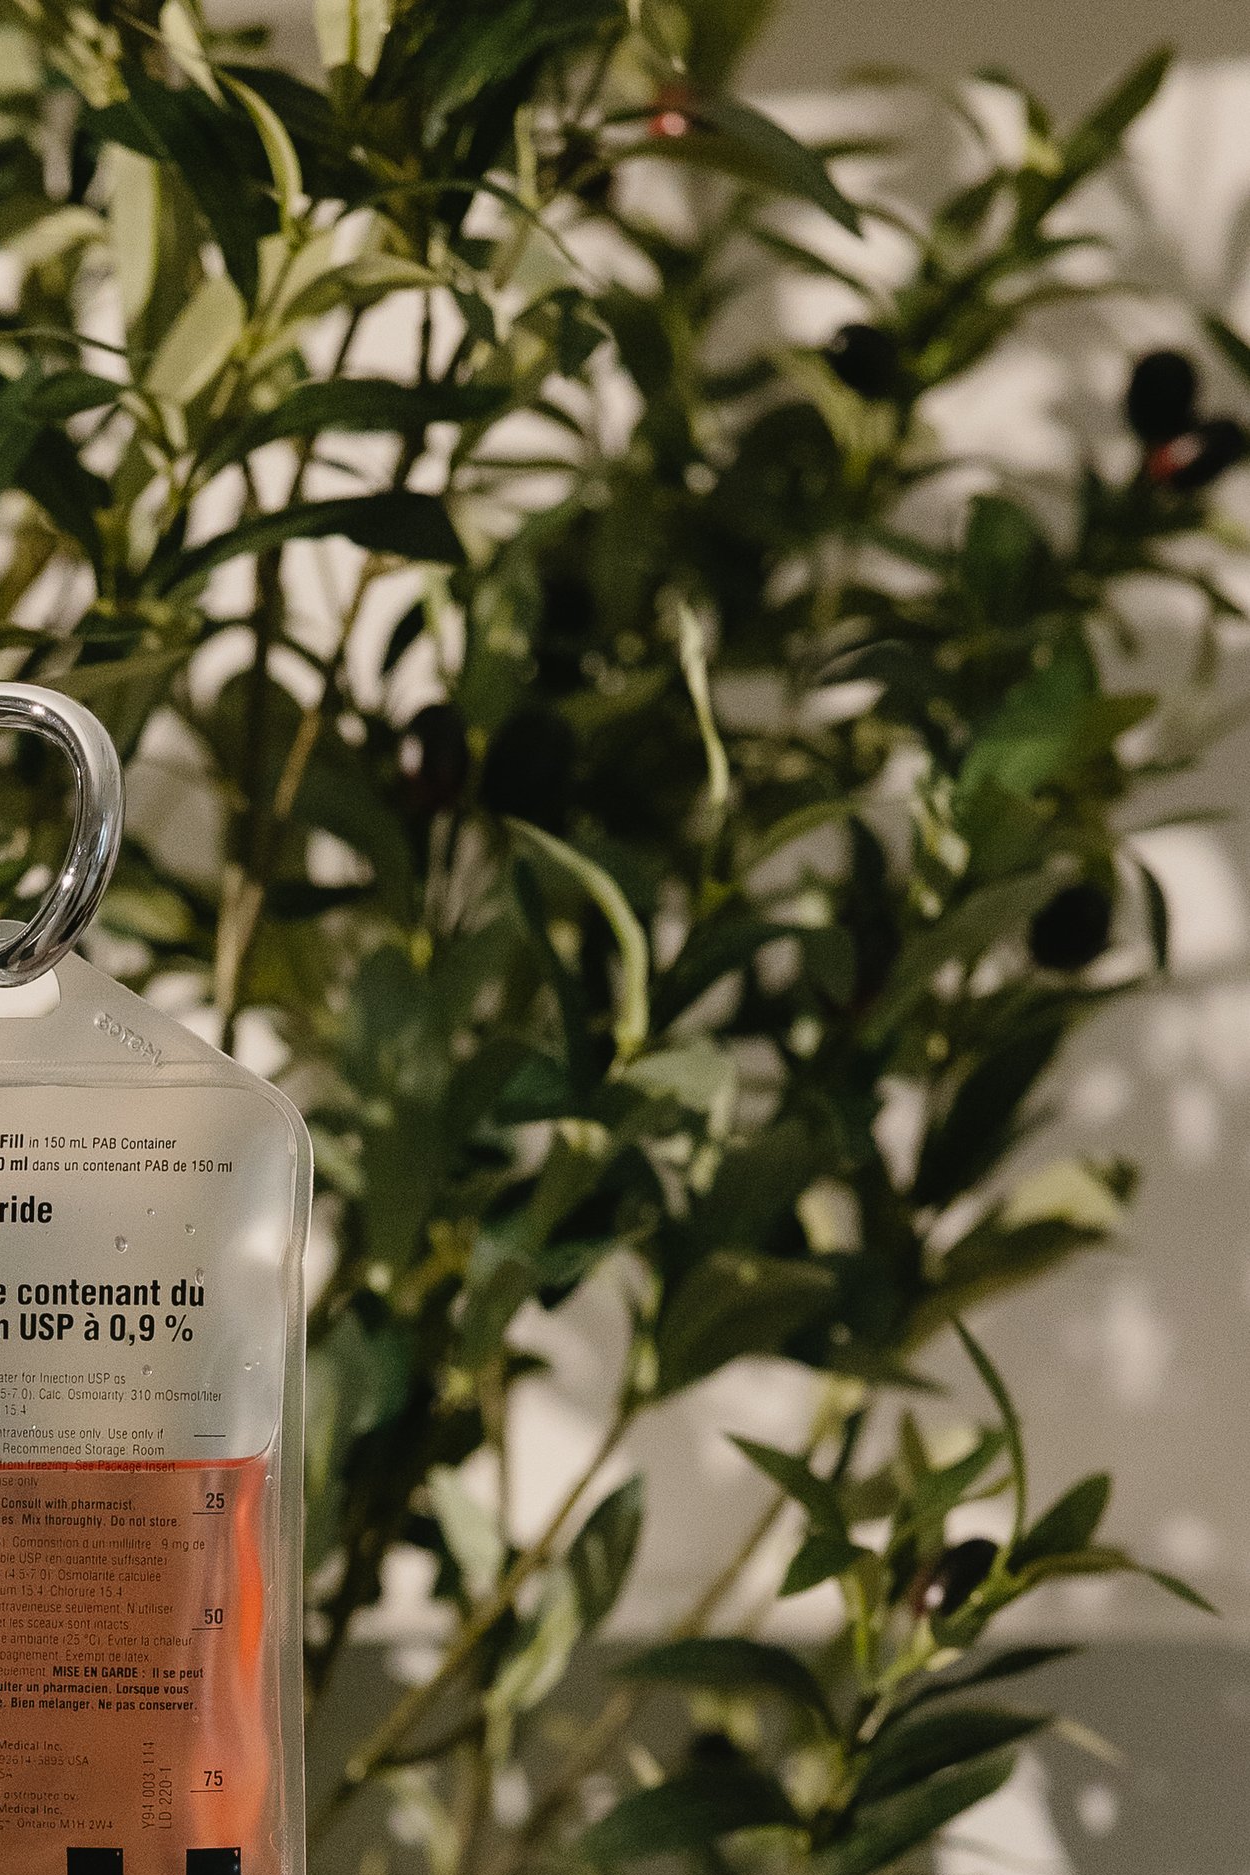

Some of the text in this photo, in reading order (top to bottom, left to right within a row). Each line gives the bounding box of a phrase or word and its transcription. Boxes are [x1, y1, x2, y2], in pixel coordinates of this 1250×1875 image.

[0, 1134, 24, 1149] Fill
[28, 1137, 39, 1149] in
[44, 1136, 66, 1149] 150
[69, 1137, 88, 1149] mL
[92, 1137, 117, 1149] PAB
[121, 1137, 177, 1150] Container
[10, 1156, 28, 1171] ml
[32, 1160, 60, 1172] dans
[64, 1162, 79, 1172] un
[82, 1160, 141, 1173] contenant
[144, 1160, 169, 1173] PAB
[173, 1160, 187, 1173] de
[191, 1160, 214, 1173] 150
[217, 1161, 233, 1174] ml
[17, 1278, 161, 1307] contenant
[171, 1278, 205, 1307] du
[19, 1313, 74, 1341] USP
[84, 1312, 99, 1341] à
[109, 1313, 155, 1346] 0,9
[165, 1314, 194, 1342] %
[22, 1372, 36, 1384] for
[40, 1373, 84, 1385] Injection
[88, 1373, 110, 1385] USP
[130, 1389, 151, 1401] 310
[57, 1429, 76, 1439] use
[108, 1428, 128, 1439] Use
[157, 1428, 165, 1439] if
[132, 1443, 165, 1456] Room
[0, 1497, 41, 1509] Consult
[44, 1497, 68, 1510] with
[205, 1492, 225, 1510] 25
[21, 1513, 41, 1525] Mix
[45, 1514, 106, 1528] thoroughly.
[110, 1515, 125, 1527] Do
[129, 1515, 146, 1527] not
[149, 1515, 181, 1528] store.
[172, 1540, 205, 1552] mg de
[204, 1607, 224, 1625] 50
[52, 1665, 80, 1677] MISE
[83, 1666, 98, 1678] EN
[101, 1666, 139, 1678] GARDE
[152, 1667, 160, 1679] Il
[163, 1670, 176, 1680] se
[179, 1668, 204, 1681] peut
[26, 1683, 40, 1693] un
[43, 1682, 112, 1695] pharmacien.
[116, 1683, 160, 1696] Lorsque
[163, 1685, 190, 1695] vous
[10, 1697, 35, 1709] Bien
[98, 1698, 111, 1710] Ne
[116, 1701, 135, 1712] pas
[139, 1700, 198, 1711] conserver.
[43, 1741, 63, 1752] Inc.
[67, 1755, 90, 1766] USA
[141, 1772, 155, 1798] 003
[203, 1770, 223, 1787] 75
[158, 1767, 172, 1829] LD 220-1
